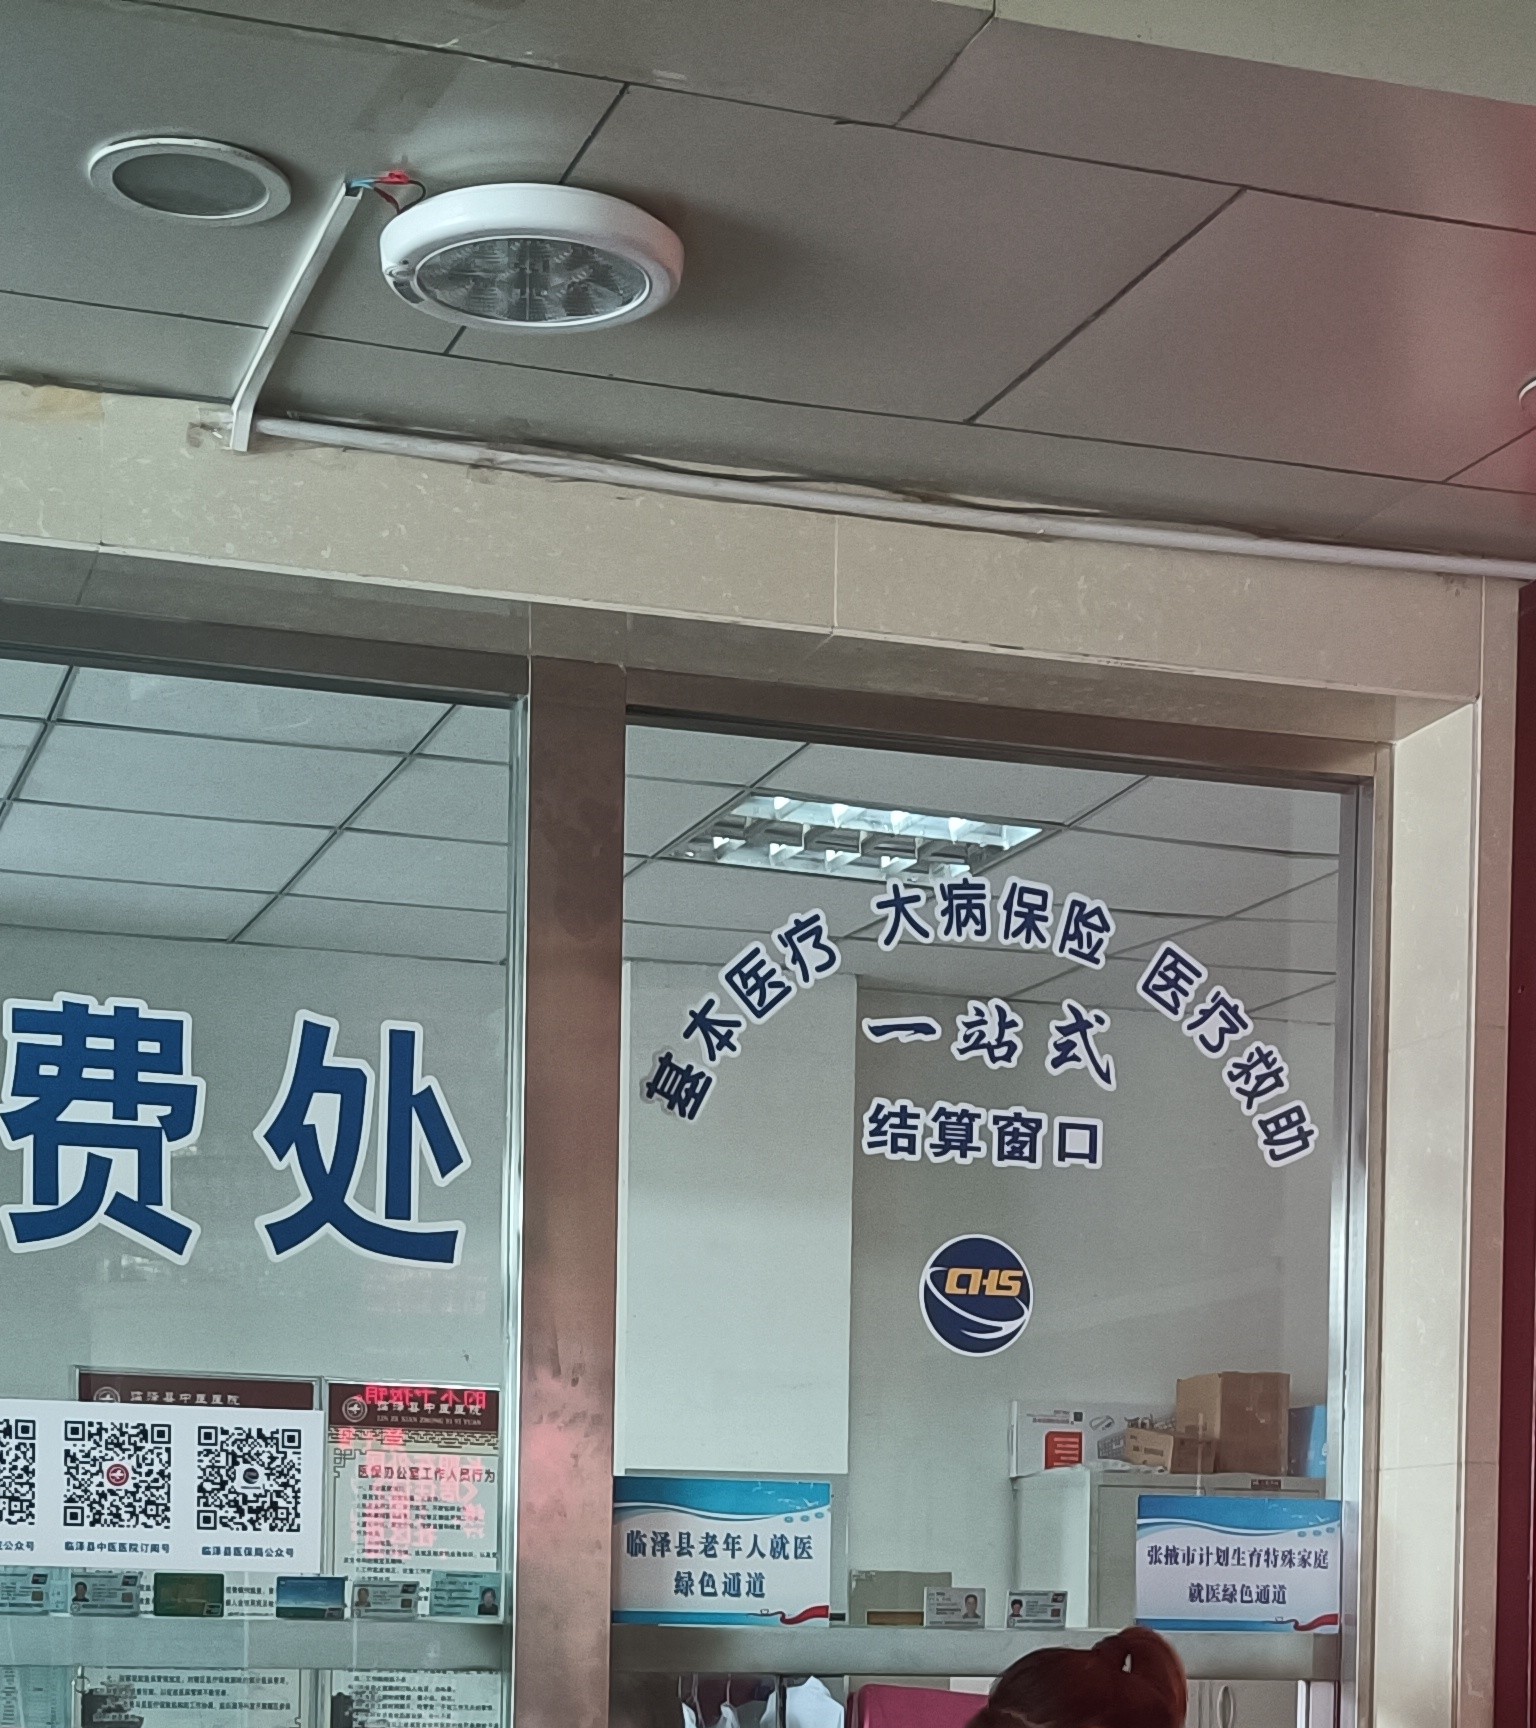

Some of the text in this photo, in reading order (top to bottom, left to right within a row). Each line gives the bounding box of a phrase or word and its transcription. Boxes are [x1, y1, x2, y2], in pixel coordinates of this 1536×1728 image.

[645, 881, 1316, 1163] 基本医疗 大病保险 医疗救助
[864, 1003, 1116, 1089] 一站式
[866, 1104, 1103, 1164] 结算窗口
[945, 1267, 1024, 1298] CHS
[625, 1529, 814, 1560] 临泽县老年人就医
[1147, 1545, 1329, 1570] 张掖市计划生育特殊家庭
[673, 1571, 766, 1598] 绿色通道
[1188, 1583, 1288, 1605] 就医绿色通道
